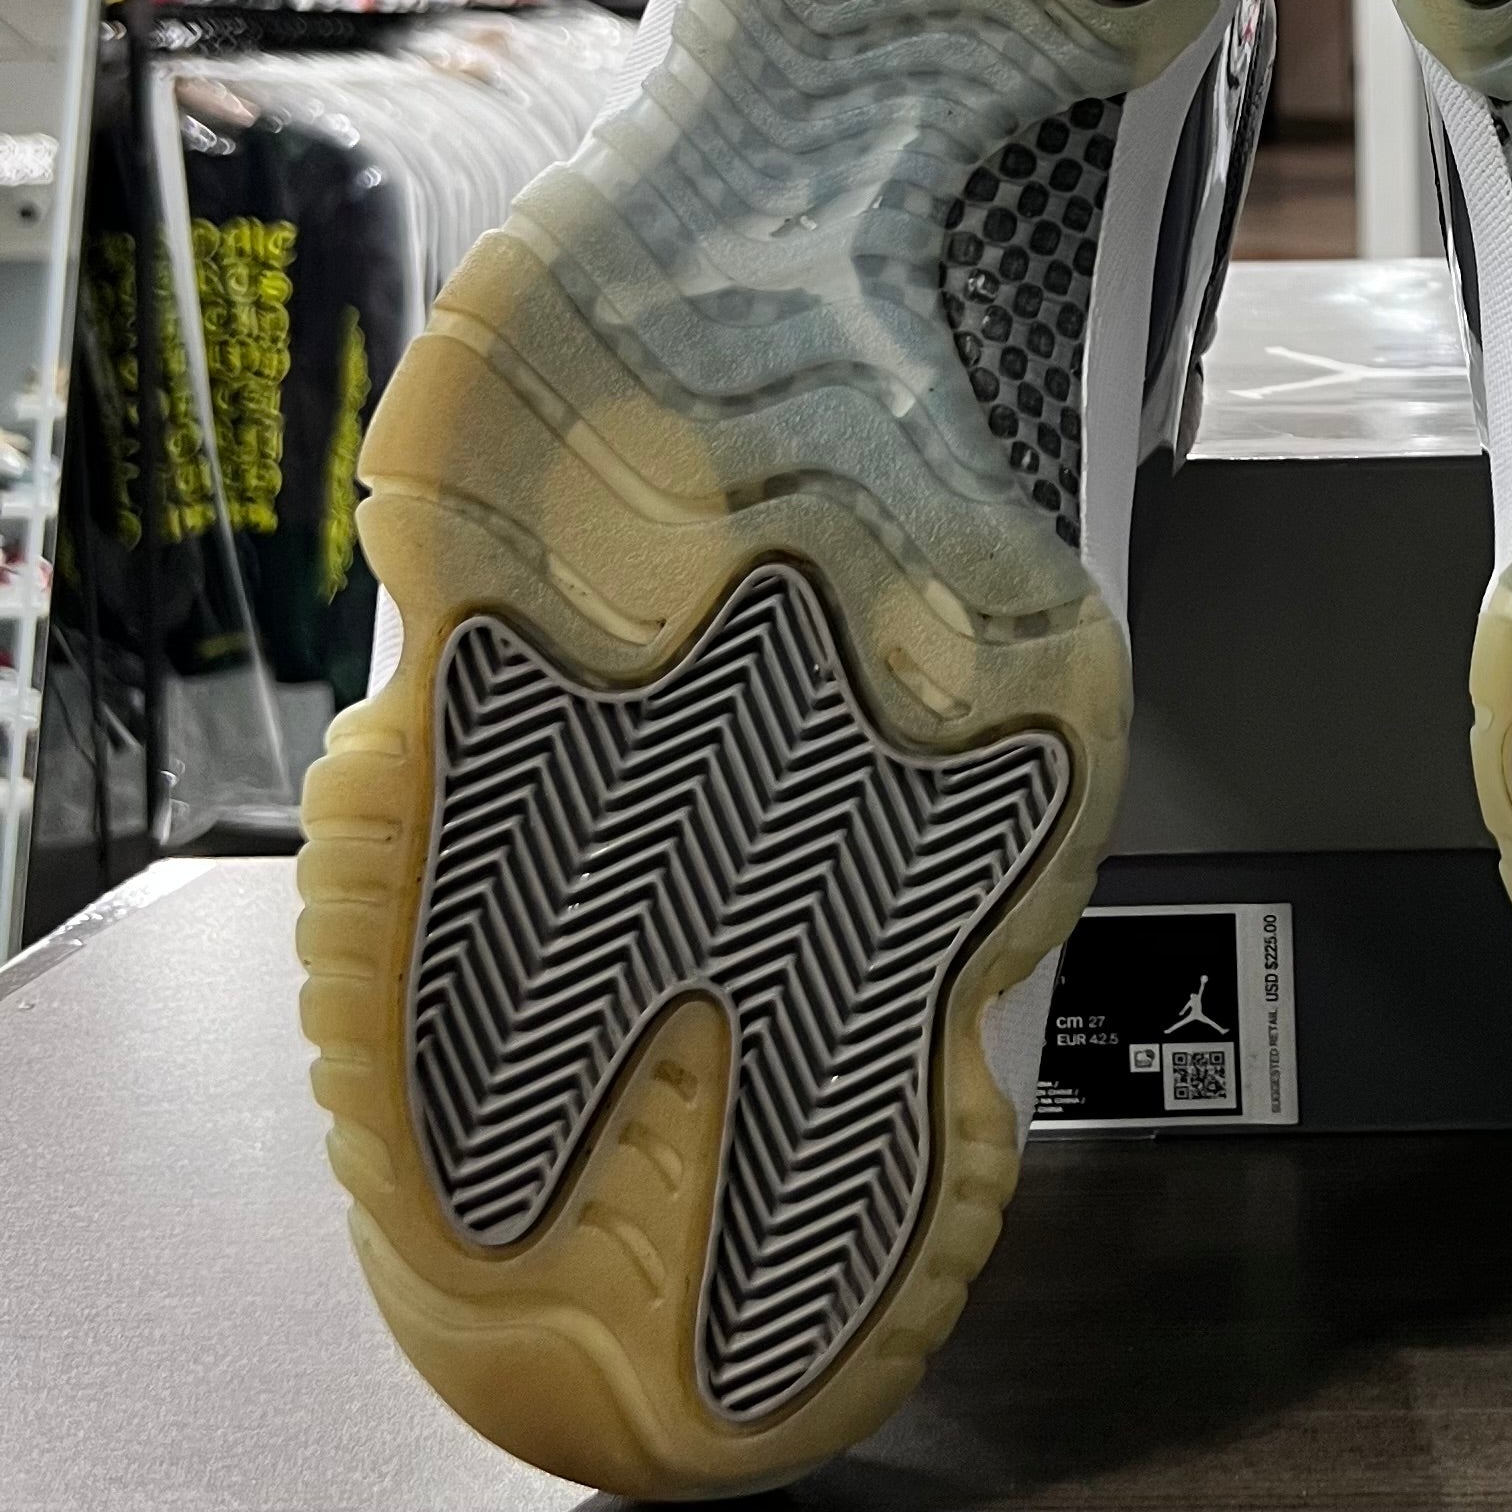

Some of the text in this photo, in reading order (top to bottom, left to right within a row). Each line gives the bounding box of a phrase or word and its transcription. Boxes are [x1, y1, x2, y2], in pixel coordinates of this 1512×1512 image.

[1264, 914, 1278, 970] $225.00
[1265, 974, 1279, 1002] USD
[1056, 1015, 1105, 1029] cm 27
[1267, 1009, 1279, 1046] RETAIL
[1057, 1033, 1119, 1046] EUR 42.5
